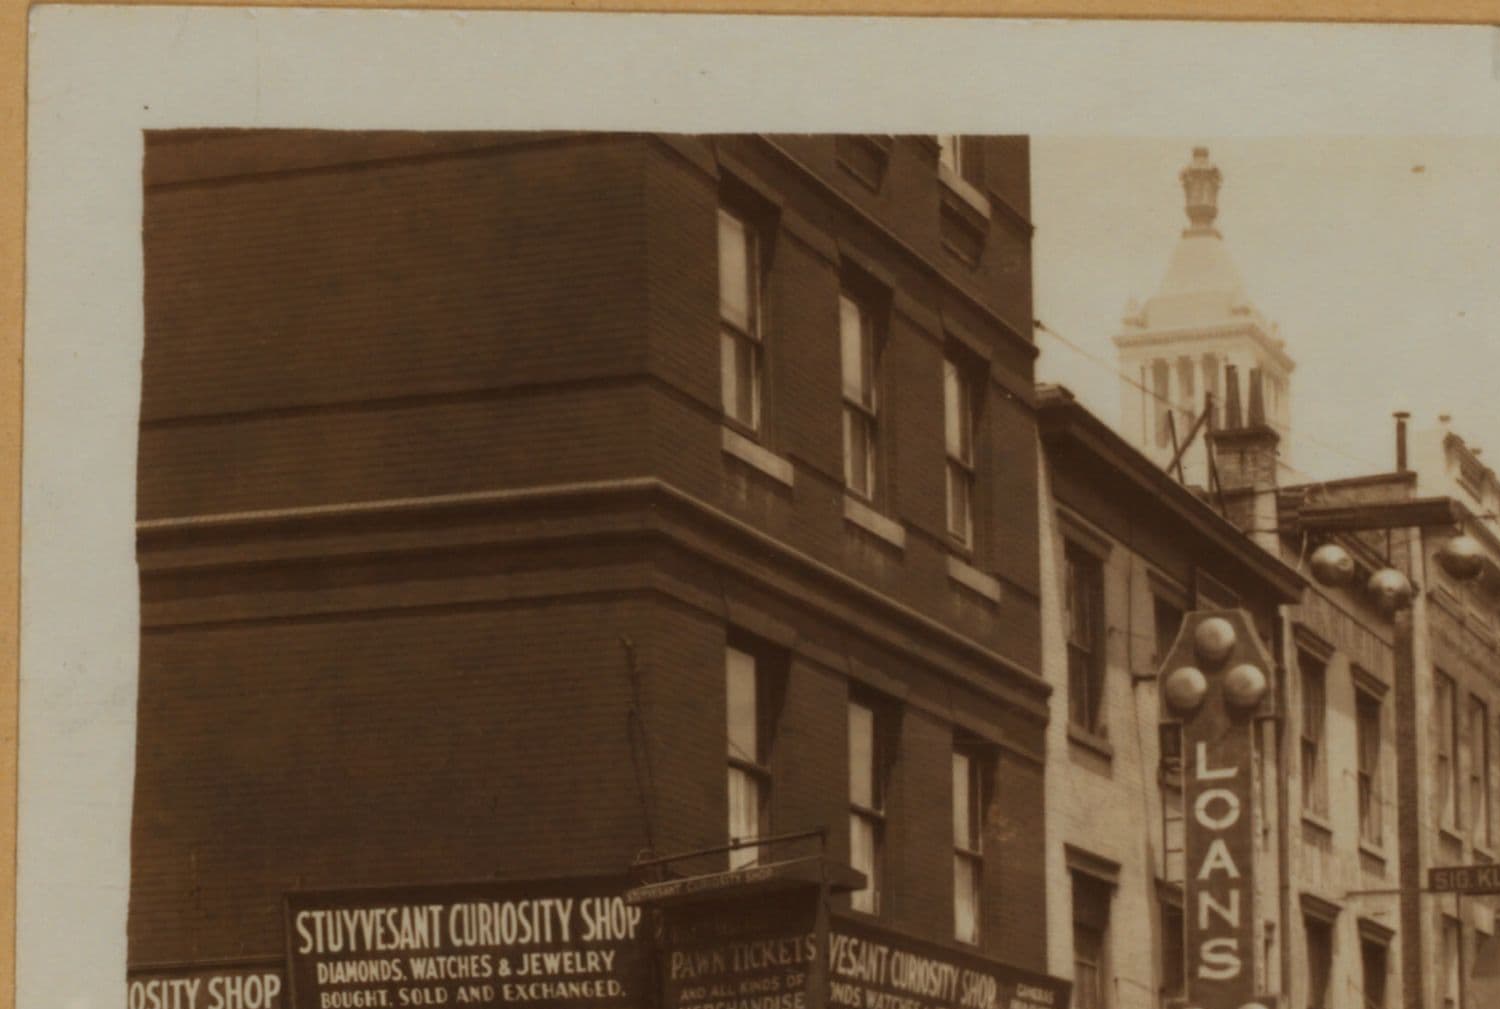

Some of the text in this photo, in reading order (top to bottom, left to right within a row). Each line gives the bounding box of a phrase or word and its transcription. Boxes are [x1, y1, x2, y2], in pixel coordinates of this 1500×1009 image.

[1194, 741, 1241, 980] LOANS
[296, 896, 642, 955] STUYVESANT CURIOSITY SHOP
[409, 954, 492, 980] WATCHES
[498, 957, 511, 977] &
[516, 950, 617, 977] JEWELRY
[671, 932, 817, 980] PAWN TICKETS
[891, 949, 961, 1003] CURIOSITY
[960, 968, 997, 1009] SHOP
[398, 986, 448, 1006] SOLD
[456, 984, 495, 1003] AND
[711, 983, 735, 999] ALL
[740, 976, 780, 994] KINDS
[786, 972, 805, 987] OF
